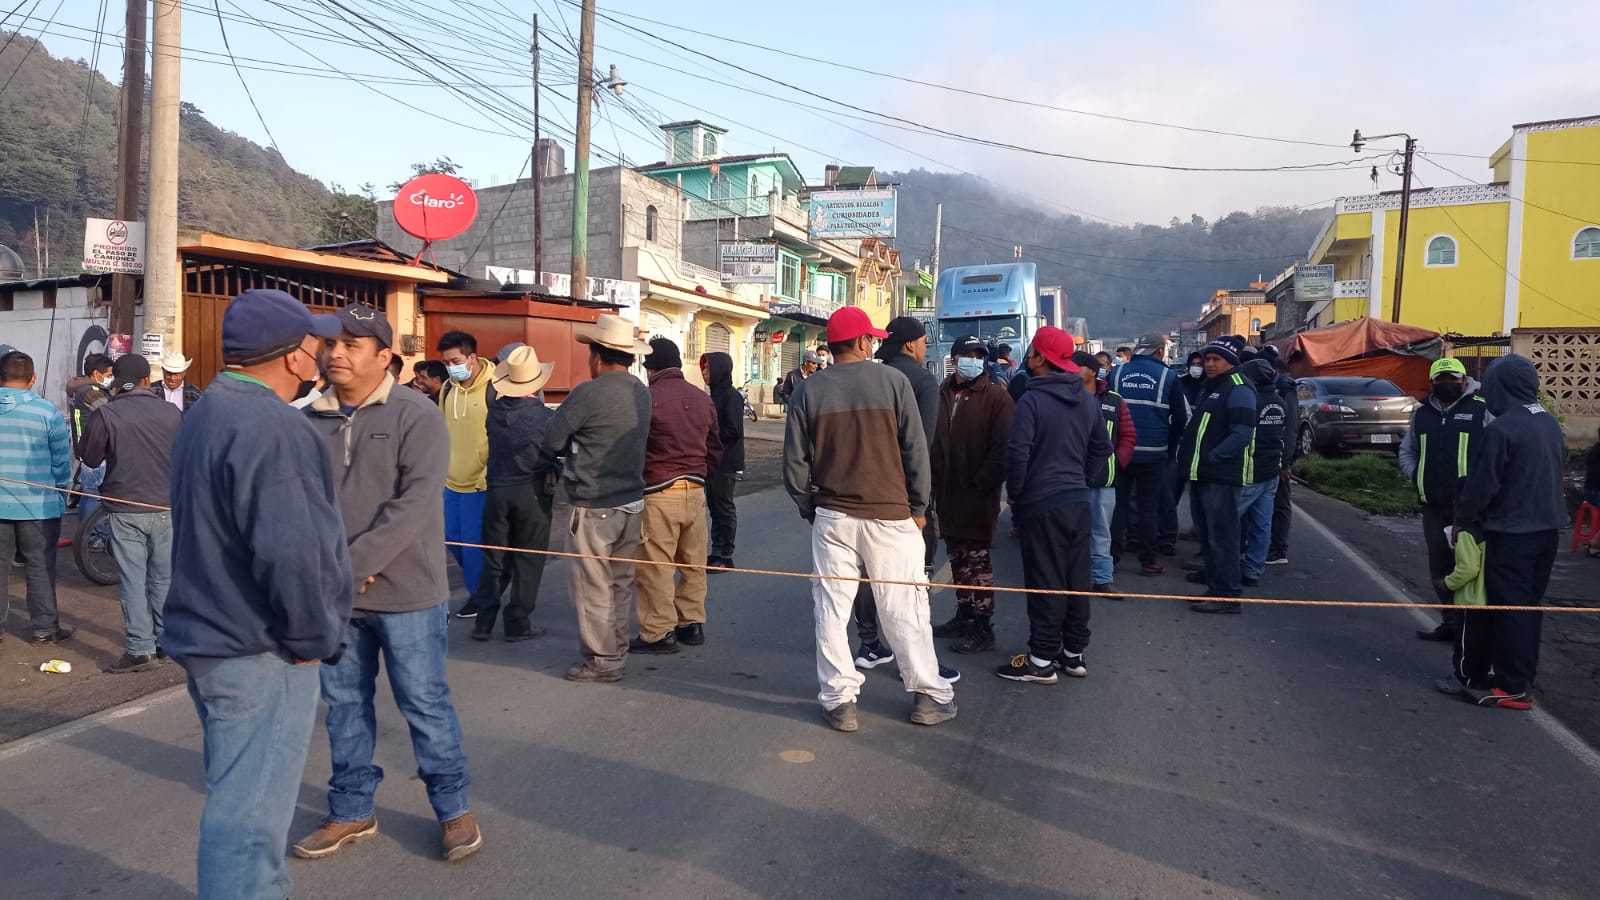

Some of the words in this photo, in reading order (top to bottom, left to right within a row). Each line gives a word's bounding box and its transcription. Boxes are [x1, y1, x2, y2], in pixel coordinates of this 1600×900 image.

[410, 191, 456, 209] Claro
[832, 211, 880, 219] CURIOSIDADES
[93, 244, 138, 252] PROHIBIDO
[722, 245, 758, 256] ALMACEN
[86, 258, 111, 266] MULTA
[94, 254, 136, 262] CAMIONES
